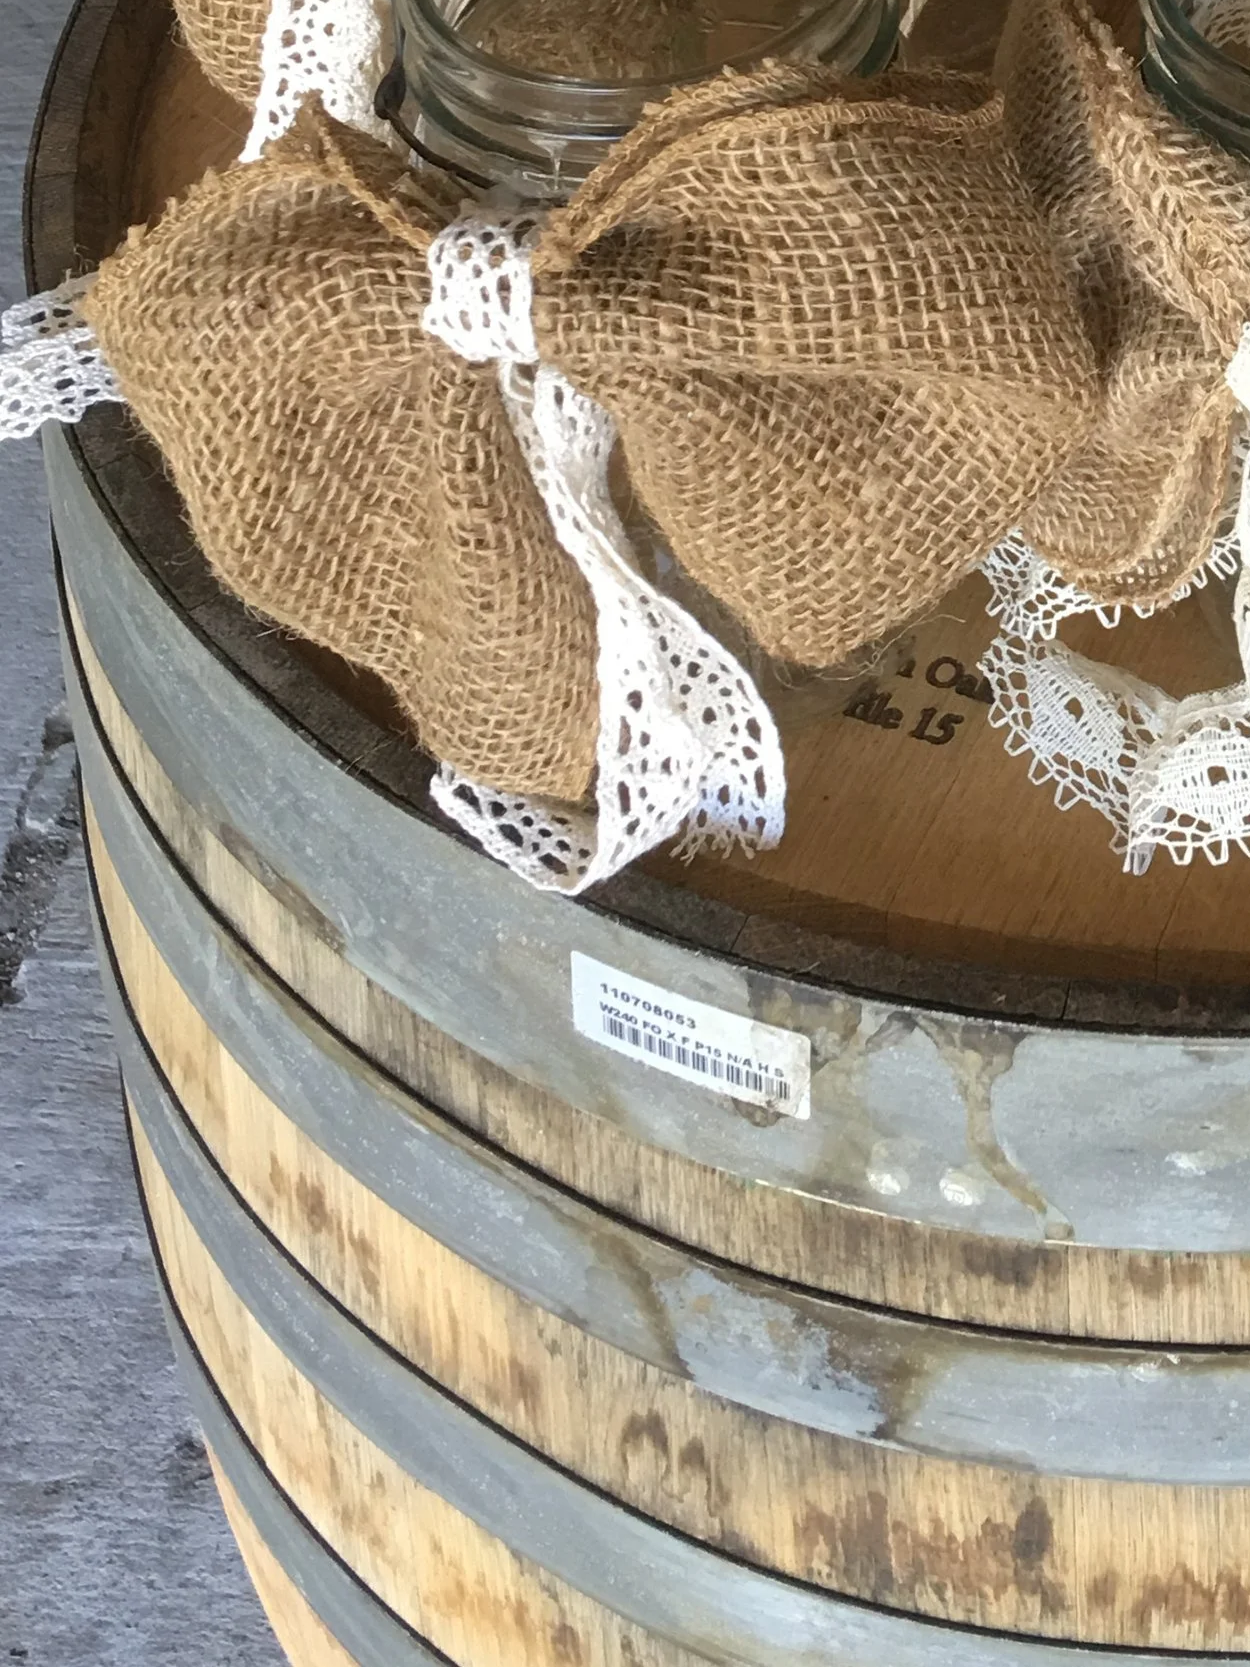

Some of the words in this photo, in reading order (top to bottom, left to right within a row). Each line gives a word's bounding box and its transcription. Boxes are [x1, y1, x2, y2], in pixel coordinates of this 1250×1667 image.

[910, 707, 965, 746] 15
[600, 983, 696, 1029] 110708053
[600, 1001, 638, 1025] W240
[667, 1030, 676, 1041] X
[727, 1052, 752, 1069] N/A
